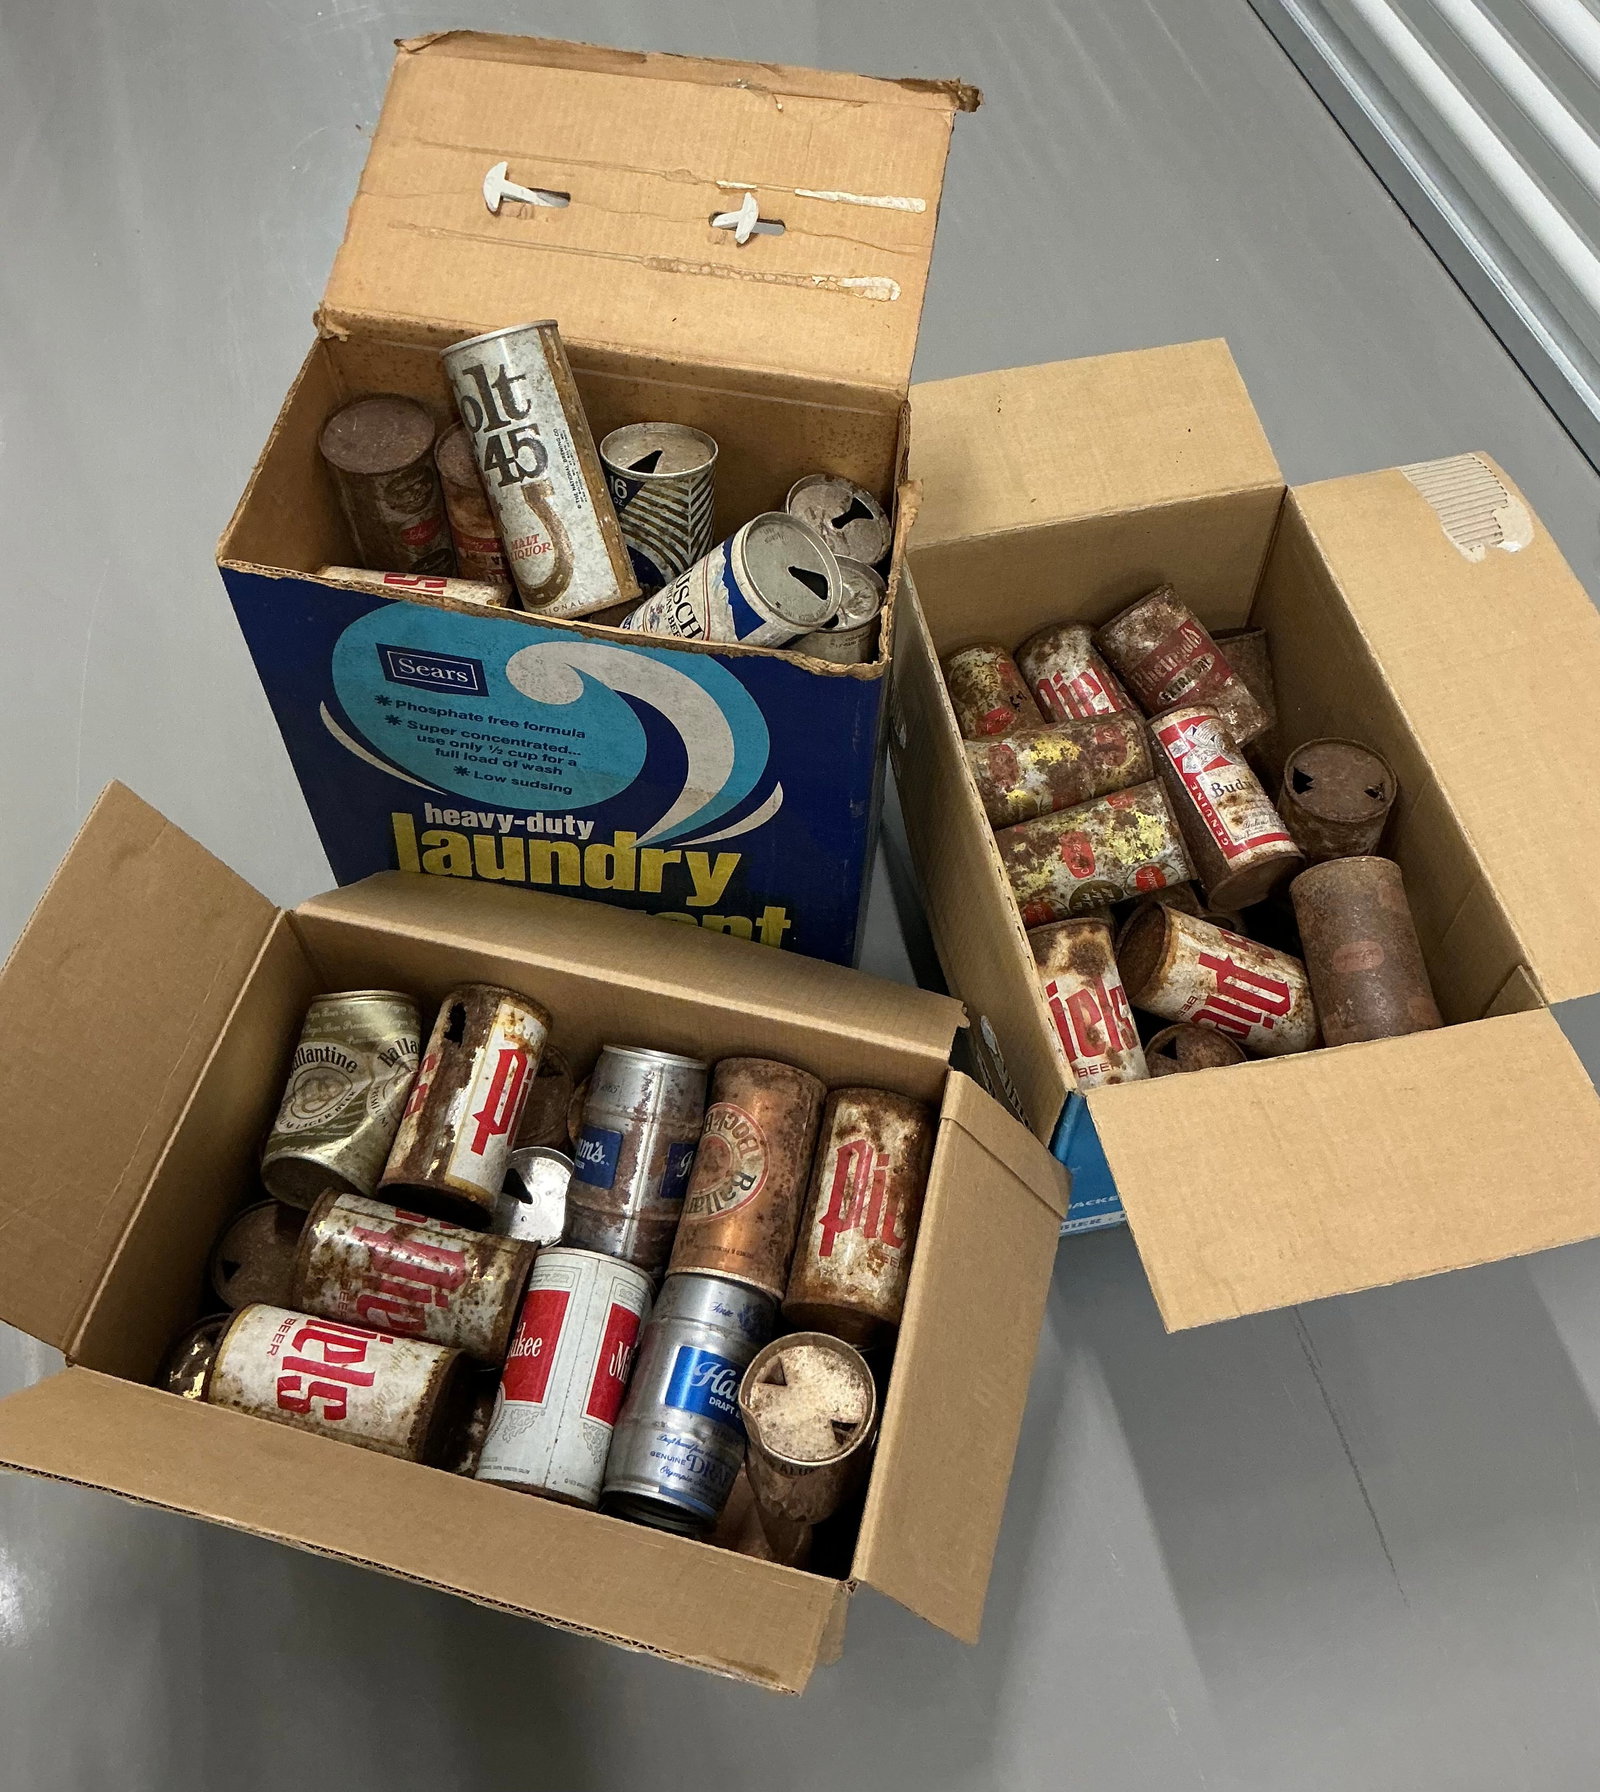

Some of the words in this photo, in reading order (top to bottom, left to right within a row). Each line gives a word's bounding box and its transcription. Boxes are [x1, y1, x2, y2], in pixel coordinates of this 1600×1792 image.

[460, 363, 532, 434] olt
[484, 422, 549, 489] 45
[565, 465, 577, 491] NATIONAL
[609, 475, 628, 499] 16
[510, 533, 540, 550] MALT
[541, 600, 584, 614] TIONAL
[674, 567, 704, 640] USCH
[667, 615, 682, 637] BEE
[397, 657, 469, 684] Sears
[395, 699, 484, 723] Phosphate
[488, 714, 520, 729] free
[523, 720, 586, 740] formula
[407, 718, 456, 736] Super
[460, 727, 582, 757] concentrated...
[416, 734, 446, 746] use
[449, 738, 483, 754] only
[508, 749, 539, 763] cup
[541, 752, 565, 765] for
[567, 757, 578, 768] a
[435, 747, 461, 759] full
[463, 751, 498, 765] load
[502, 757, 520, 769] of
[522, 762, 563, 776] wash
[474, 770, 507, 784] Low
[511, 774, 573, 796] sudsing
[424, 802, 595, 840] heavy-duty
[1190, 781, 1230, 847] GENUINE
[391, 812, 742, 907] laundry
[1045, 974, 1139, 1064] iels
[1177, 995, 1198, 1017] BEE
[291, 1046, 358, 1074] allantine
[377, 1038, 420, 1068] Balla
[1077, 1061, 1114, 1078] BEE
[712, 1111, 761, 1160] BOCK
[684, 1171, 757, 1217] Balla
[266, 1317, 297, 1357] BEER
[277, 1319, 394, 1421] iels
[708, 1396, 737, 1415] DRAFT
[649, 1450, 687, 1467] GENUINE
